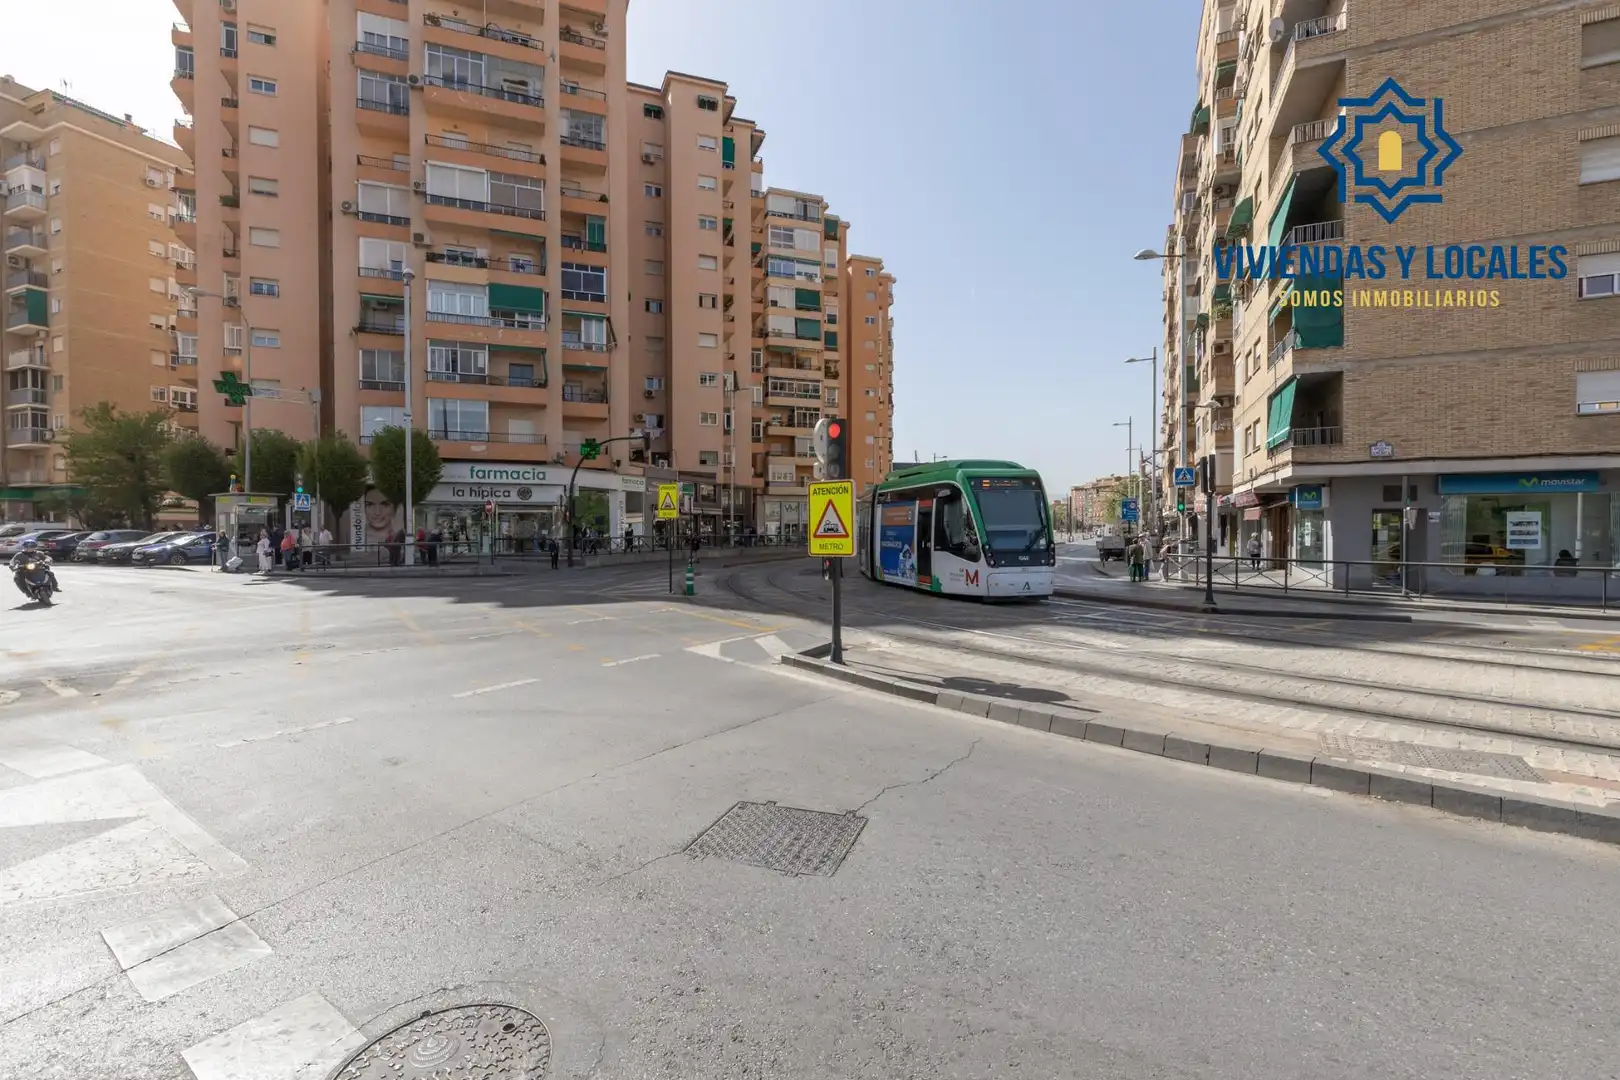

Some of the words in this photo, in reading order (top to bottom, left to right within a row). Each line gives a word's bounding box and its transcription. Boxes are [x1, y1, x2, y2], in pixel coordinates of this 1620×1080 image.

[469, 465, 547, 481] farmacia
[1540, 478, 1586, 487] movistar
[452, 486, 465, 497] la
[469, 484, 511, 500] hípica
[812, 484, 849, 496] ATENCIÓN
[818, 542, 844, 551] METRO
